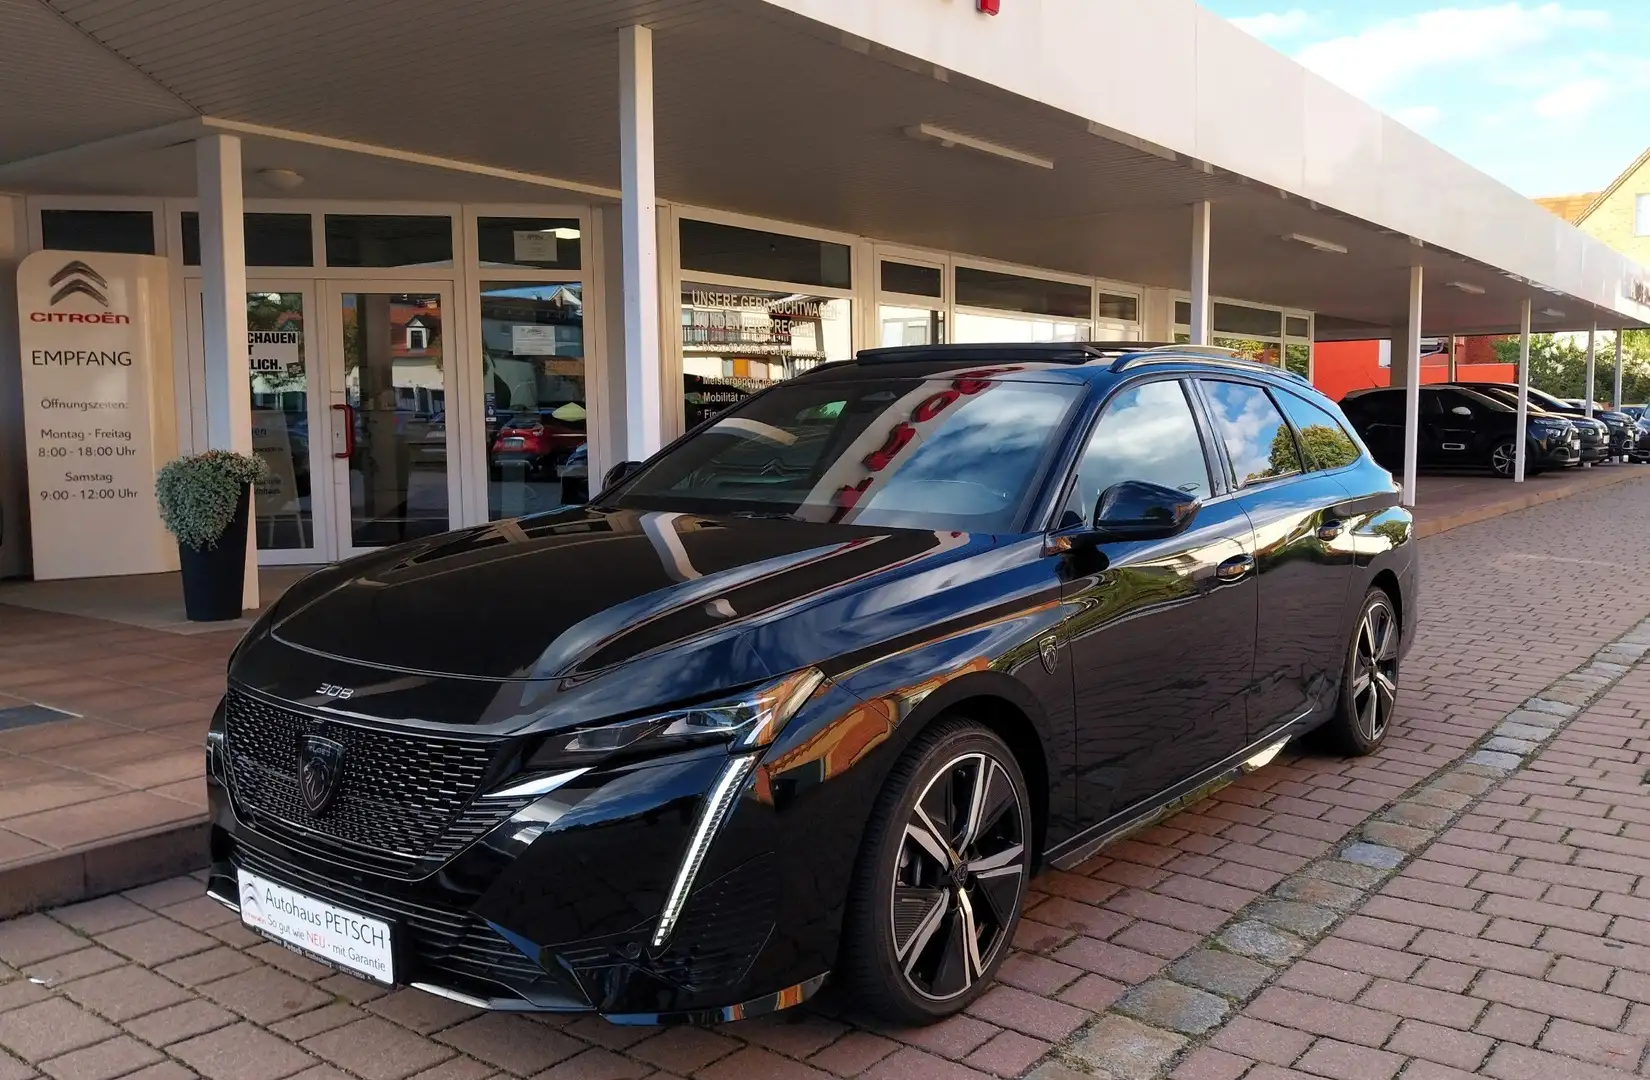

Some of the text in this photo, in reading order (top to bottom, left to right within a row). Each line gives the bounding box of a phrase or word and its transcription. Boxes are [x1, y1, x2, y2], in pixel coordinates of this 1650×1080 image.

[692, 290, 738, 308] UNSERE
[32, 350, 132, 366] EMPFANG
[703, 391, 738, 402] Mobilität
[41, 397, 129, 412] Öffnungszeiten:
[41, 429, 85, 441] Montag
[95, 428, 132, 441] Freitag
[38, 447, 67, 457] 8:00
[78, 446, 113, 456] 18:00
[116, 446, 137, 456] Uhr
[65, 472, 113, 484] Samstag
[40, 490, 69, 500] 9:00
[80, 489, 115, 499] 12:00
[118, 489, 138, 499] Uhr
[316, 682, 354, 700] 308
[265, 887, 322, 927] Autohaus
[325, 910, 385, 949] PETSCH
[267, 914, 277, 928] So
[279, 920, 291, 936] gut
[292, 928, 305, 941] wie
[306, 931, 326, 949] NEU
[332, 943, 347, 958] mit
[348, 947, 386, 972] Garantie
